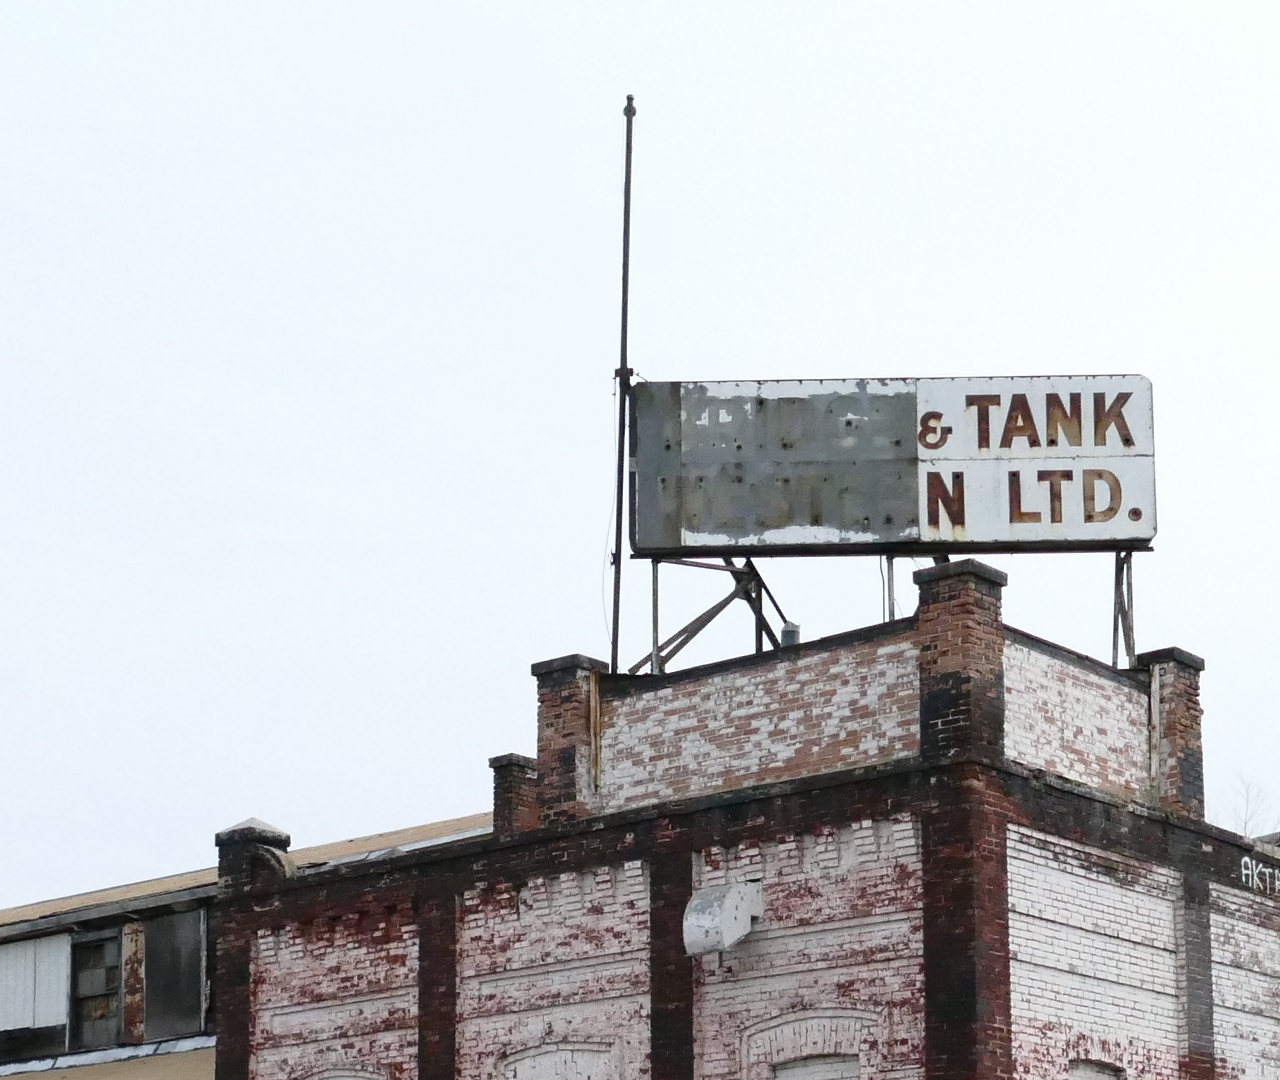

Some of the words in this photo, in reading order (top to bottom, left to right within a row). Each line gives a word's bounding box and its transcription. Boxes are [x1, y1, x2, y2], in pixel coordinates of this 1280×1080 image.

[918, 411, 952, 449] &
[965, 392, 1135, 449] TANK
[927, 471, 965, 526] N
[1008, 469, 1143, 523] LTD.
